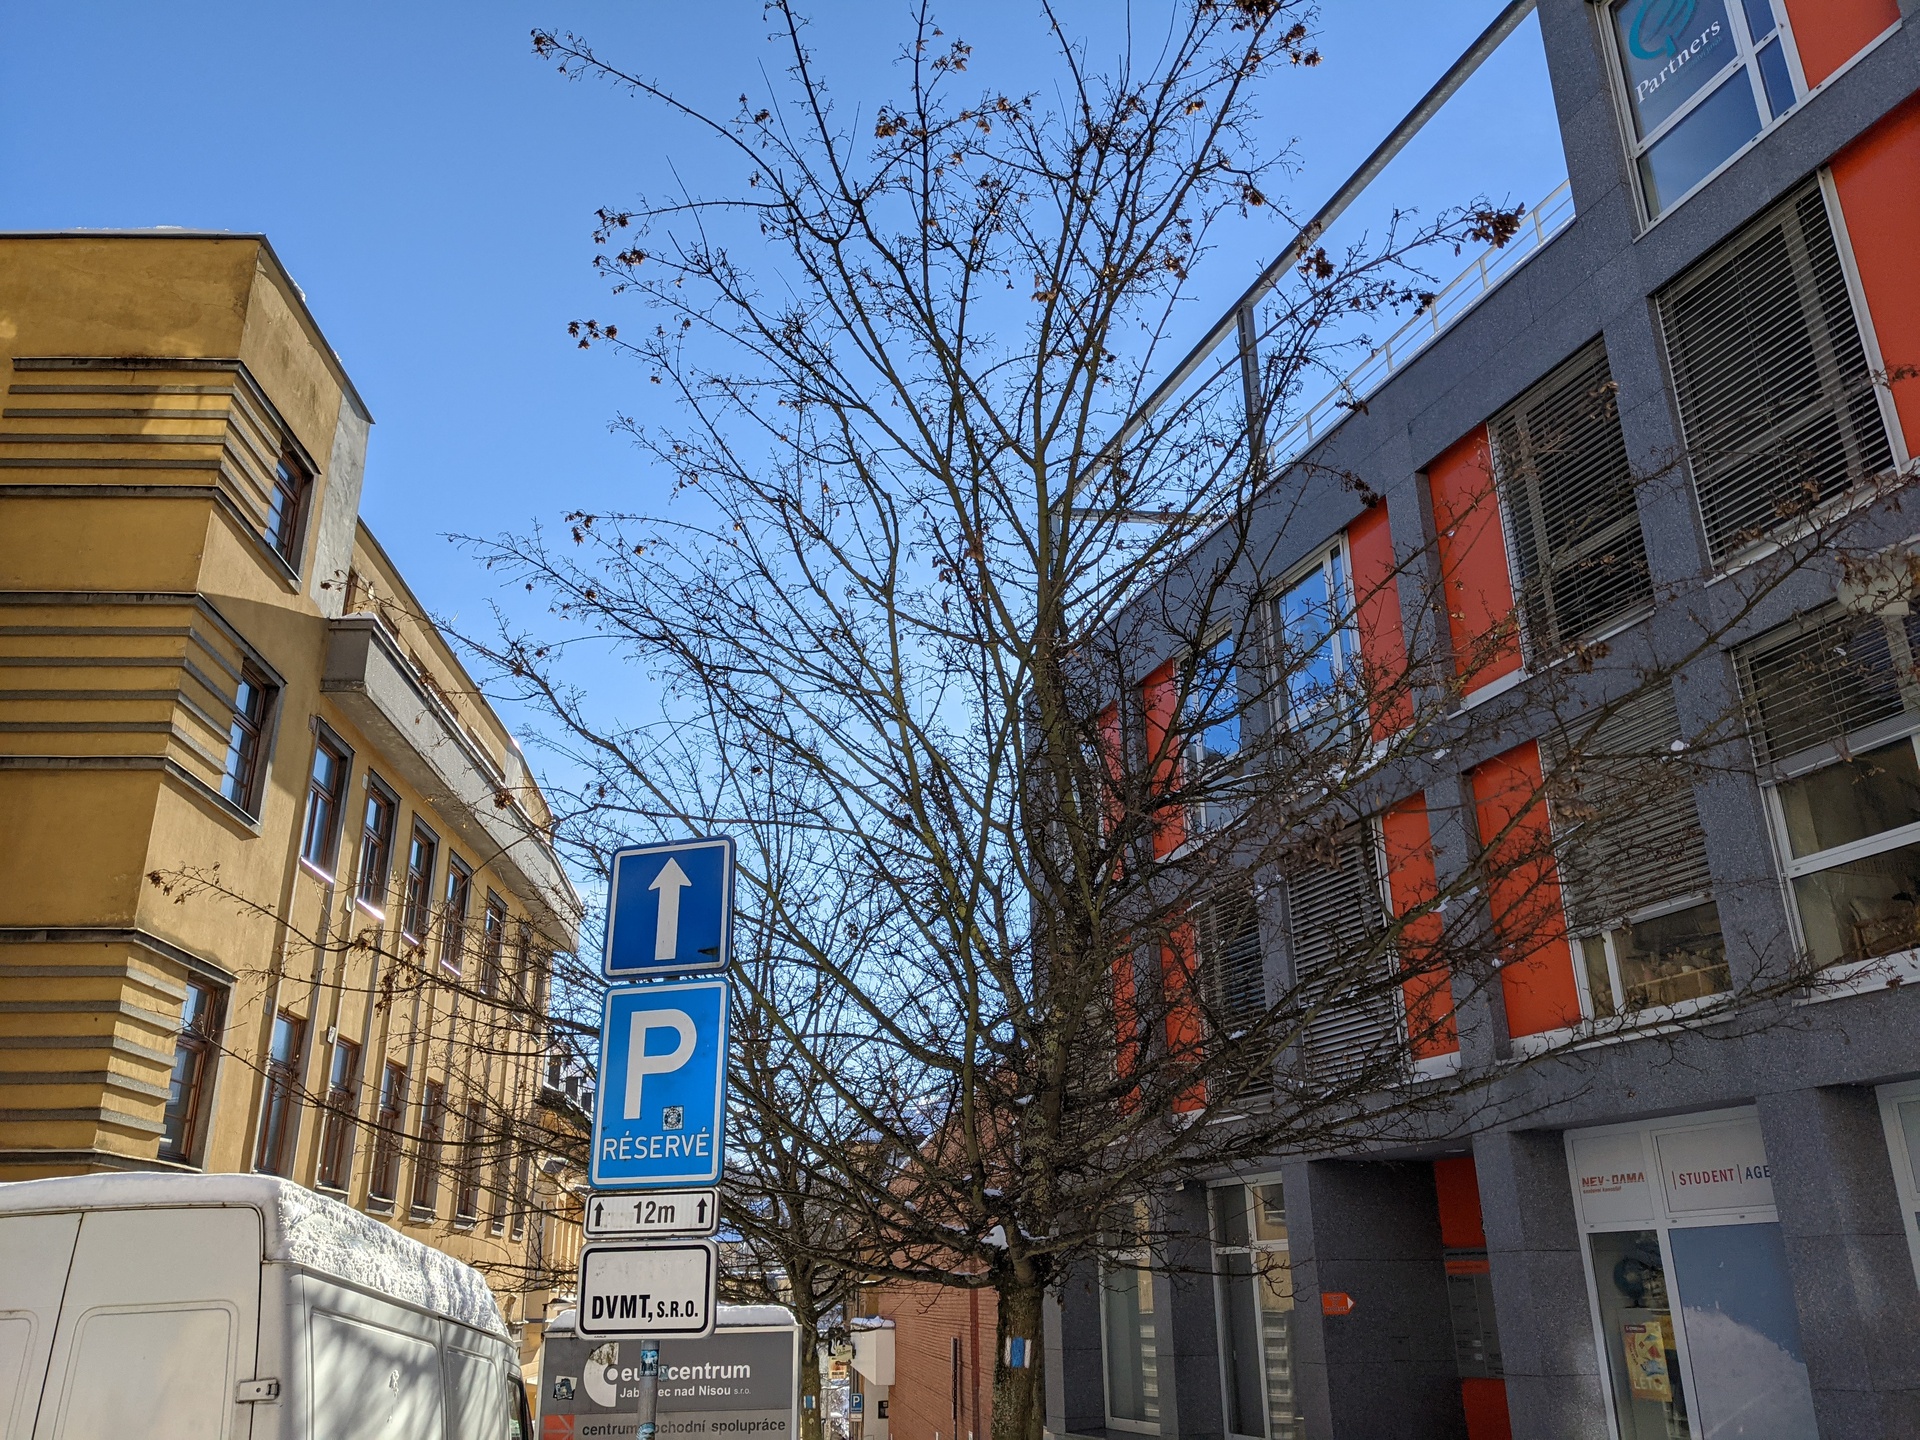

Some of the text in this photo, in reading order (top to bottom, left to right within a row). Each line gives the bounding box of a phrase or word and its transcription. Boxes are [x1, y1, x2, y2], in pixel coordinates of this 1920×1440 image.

[1635, 20, 1721, 104] Partners
[623, 1009, 697, 1119] P
[602, 1127, 710, 1160] RÉSERVÉ
[1679, 1169, 1734, 1186] STUDENT
[633, 1200, 676, 1224] 12m
[592, 1294, 699, 1323] DVMT, S.R.O.
[620, 1386, 671, 1398] Jabec
[674, 1386, 695, 1397] nad
[699, 1386, 731, 1396] Nisou
[711, 1418, 786, 1435] spolupráce
